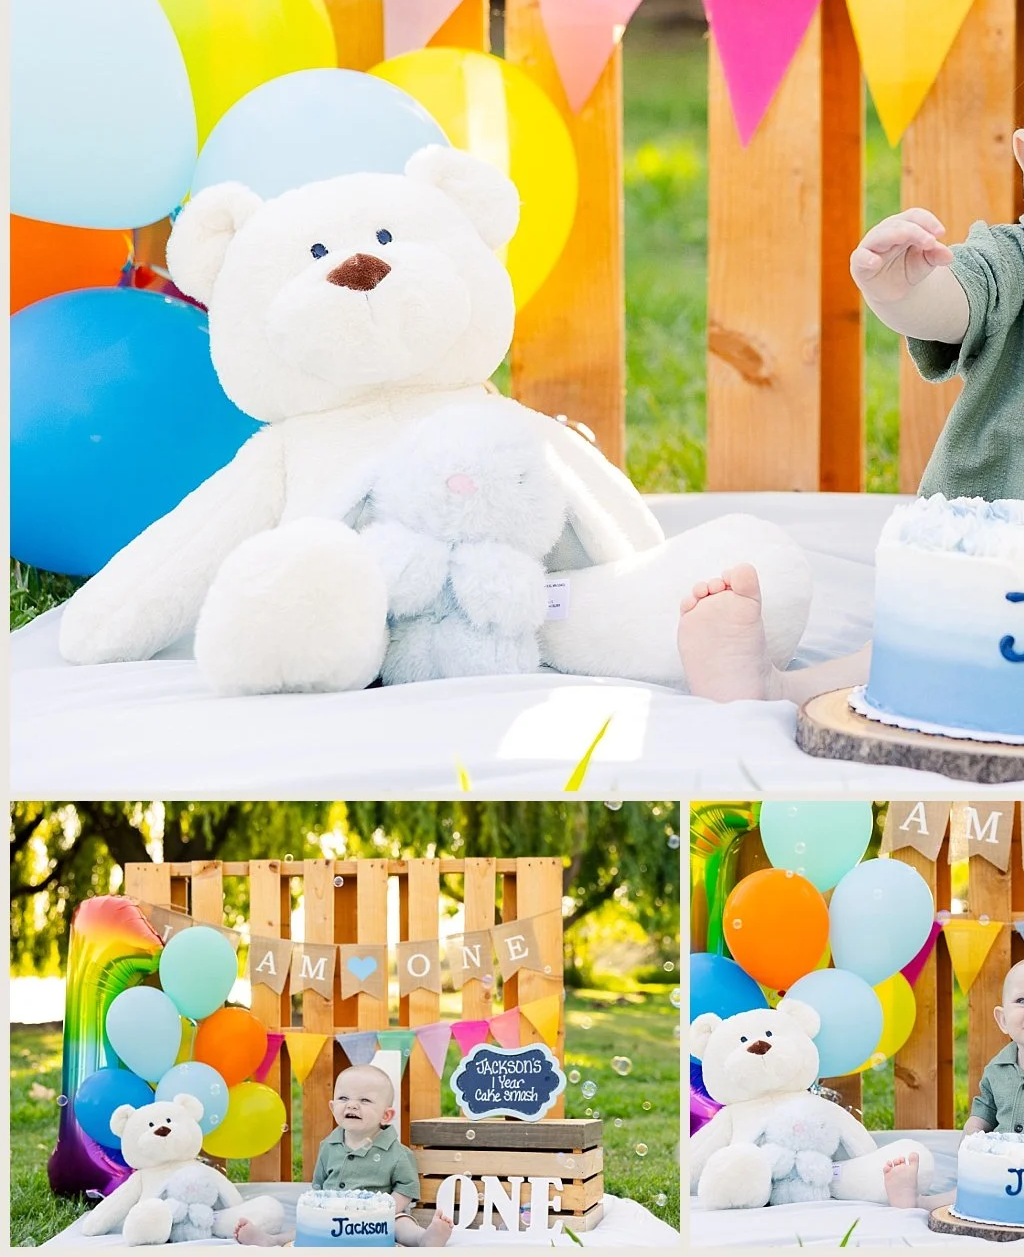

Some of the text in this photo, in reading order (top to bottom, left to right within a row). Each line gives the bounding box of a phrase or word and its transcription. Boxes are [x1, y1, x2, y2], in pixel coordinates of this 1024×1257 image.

[407, 934, 529, 977] ONE
[498, 1076, 526, 1089] Year
[436, 1174, 564, 1234] ONE
[331, 1217, 388, 1238] Jackson
